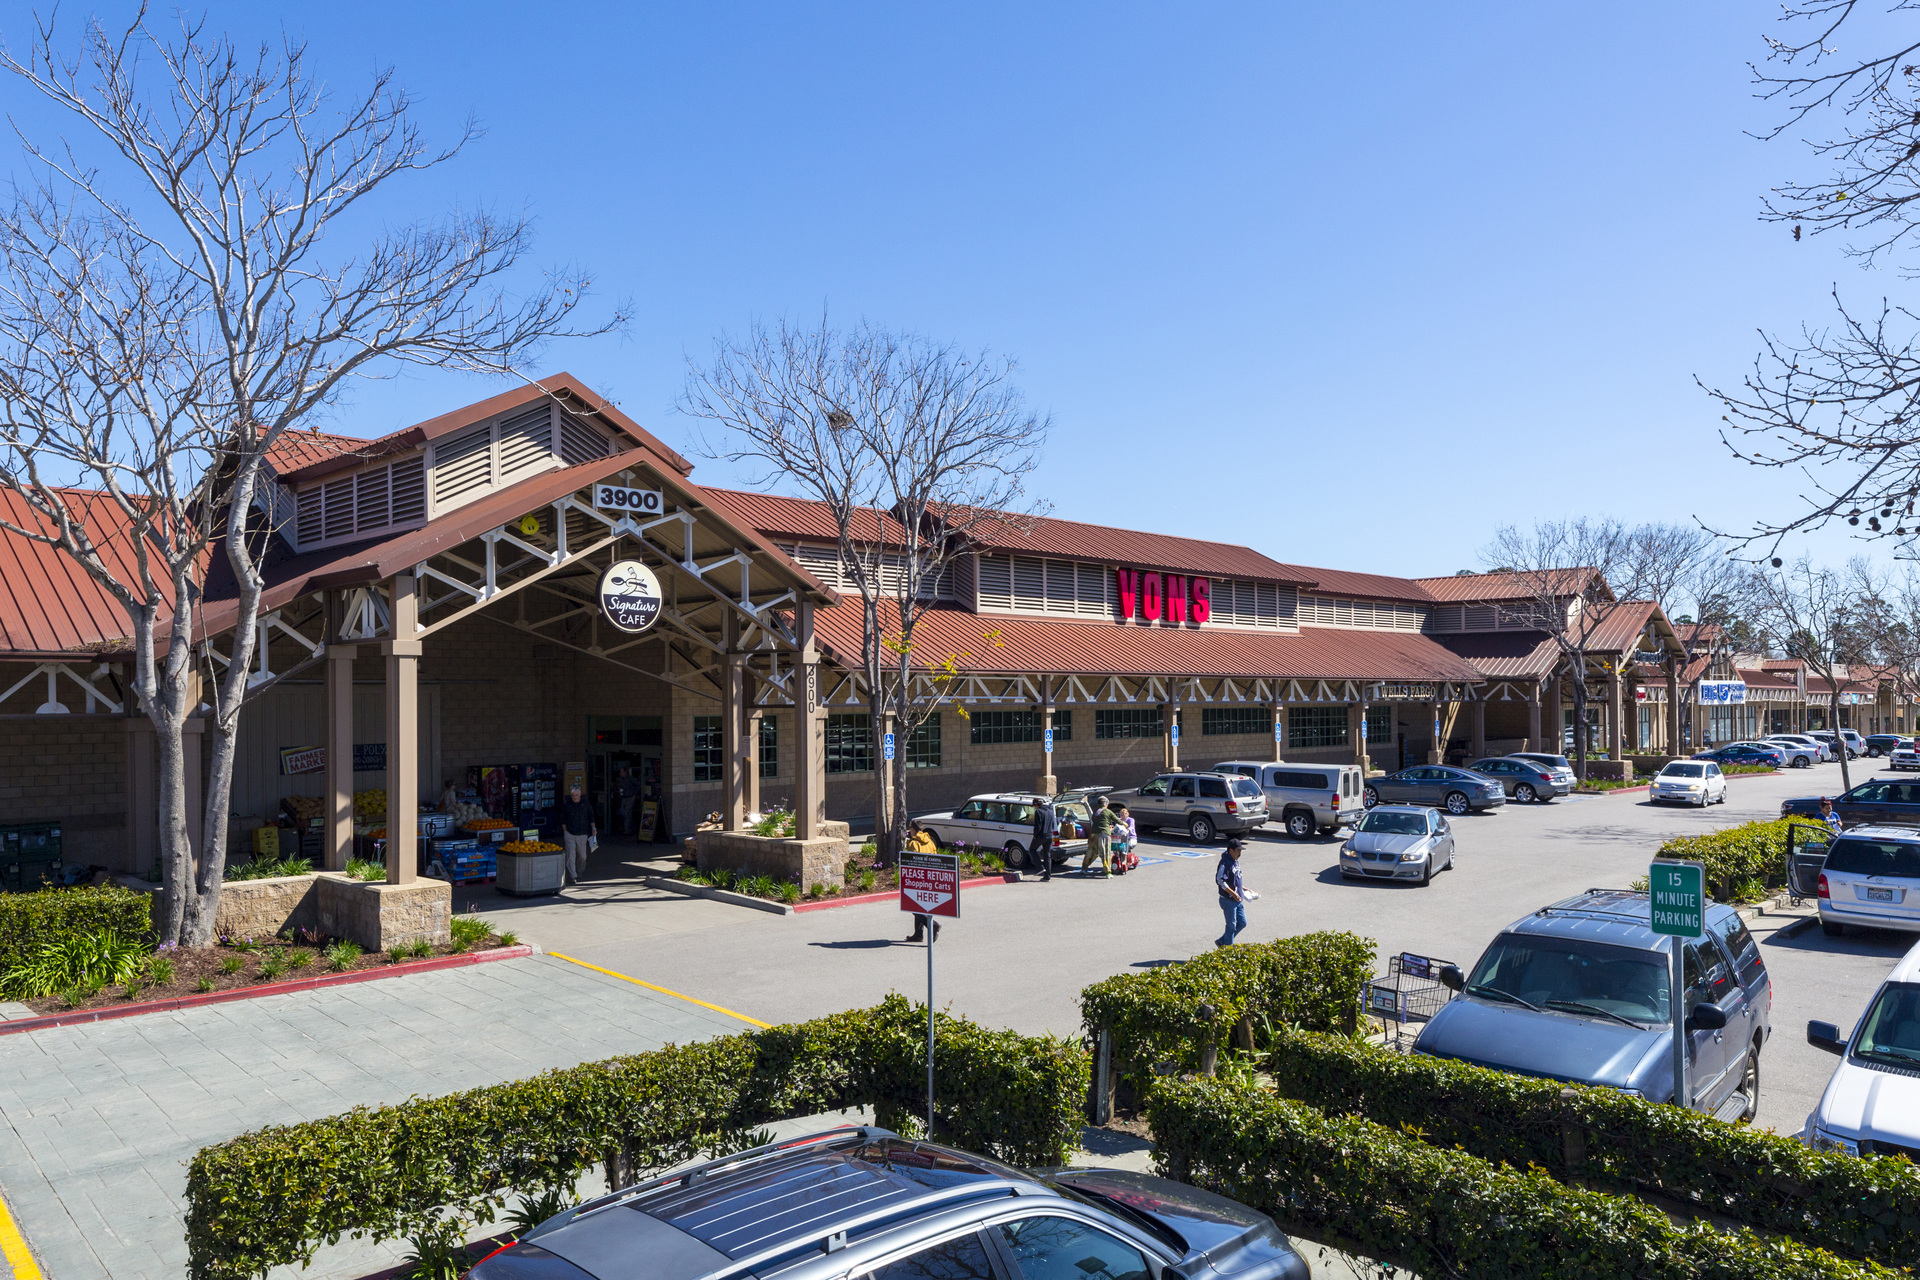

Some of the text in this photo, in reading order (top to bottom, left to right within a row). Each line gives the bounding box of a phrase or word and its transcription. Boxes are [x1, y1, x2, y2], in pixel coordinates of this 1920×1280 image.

[600, 487, 659, 510] 3900
[1116, 569, 1210, 623] VONS
[608, 596, 657, 614] Signature
[619, 613, 646, 625] CAFE
[1381, 686, 1436, 698] WELLS FARGO
[1702, 685, 1718, 700] BIG
[1718, 684, 1729, 701] 5
[288, 750, 325, 765] FARMER
[290, 757, 325, 772] MARKE
[901, 868, 954, 882] PLEASE RETURN
[1668, 872, 1682, 887] 15
[904, 878, 951, 890] Shopping Carts
[916, 891, 939, 903] HERE
[1656, 890, 1696, 907] MINUTE
[1654, 910, 1699, 928] PARKING
